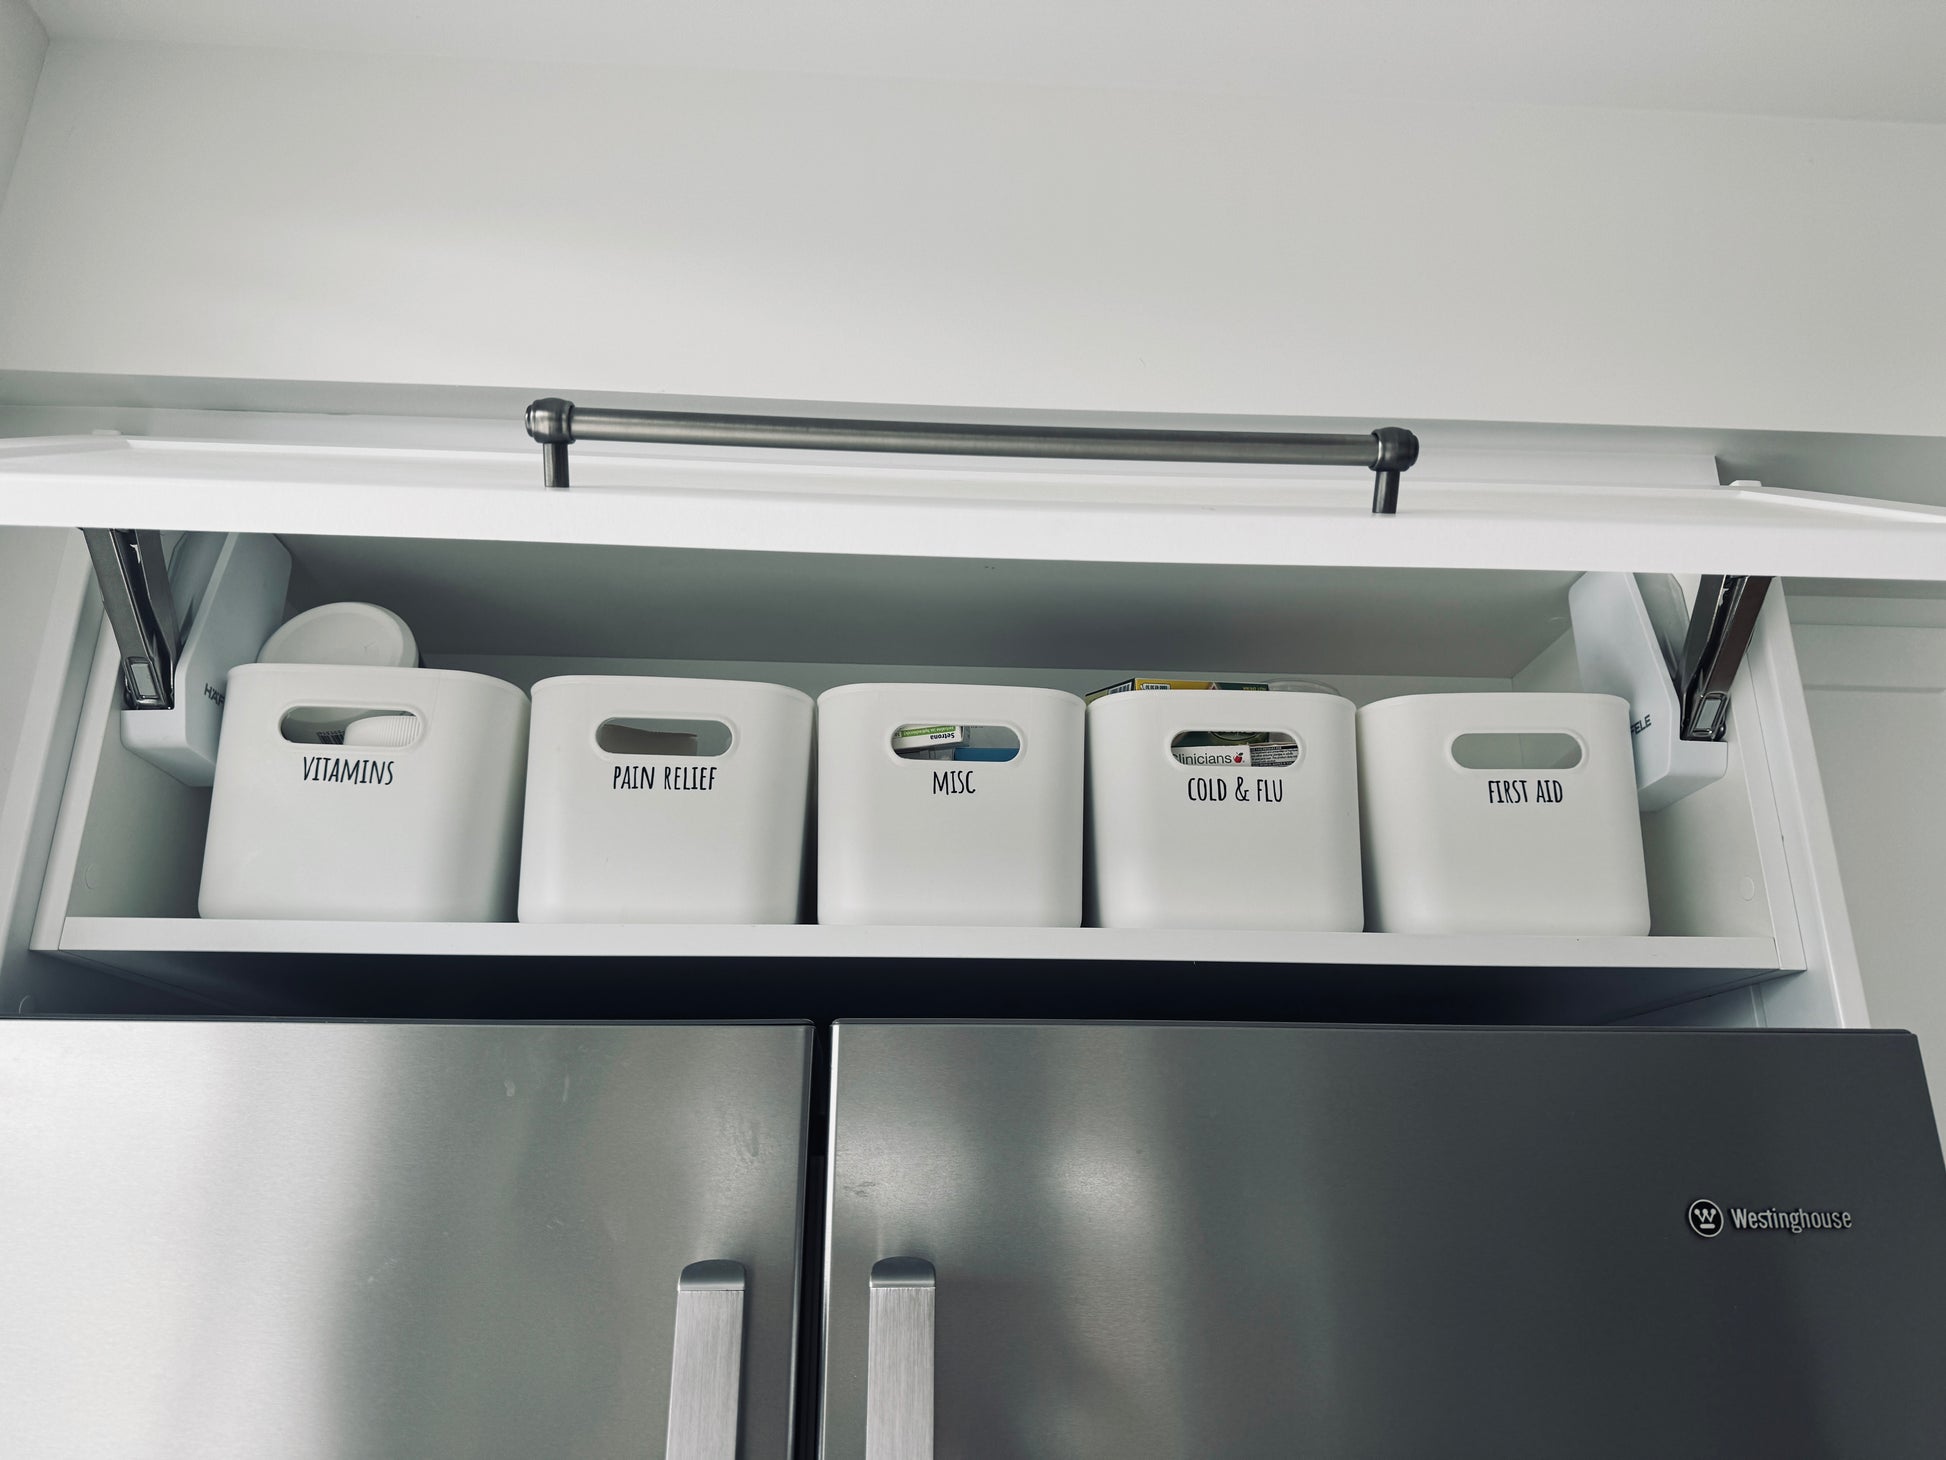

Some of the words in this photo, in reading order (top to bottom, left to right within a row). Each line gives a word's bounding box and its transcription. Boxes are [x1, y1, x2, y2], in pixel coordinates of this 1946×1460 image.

[930, 732, 955, 740] Setrona
[303, 756, 395, 786] VITAMINS
[613, 765, 655, 790] PAIN
[664, 766, 717, 790] RELIEF
[933, 770, 976, 796] MISC
[1188, 777, 1227, 802] COLD
[1235, 776, 1250, 802] &
[1257, 778, 1283, 802] FLU
[1487, 779, 1528, 804] FIRST
[1536, 779, 1563, 803] AID
[1730, 1207, 1853, 1234] Westinghouse
